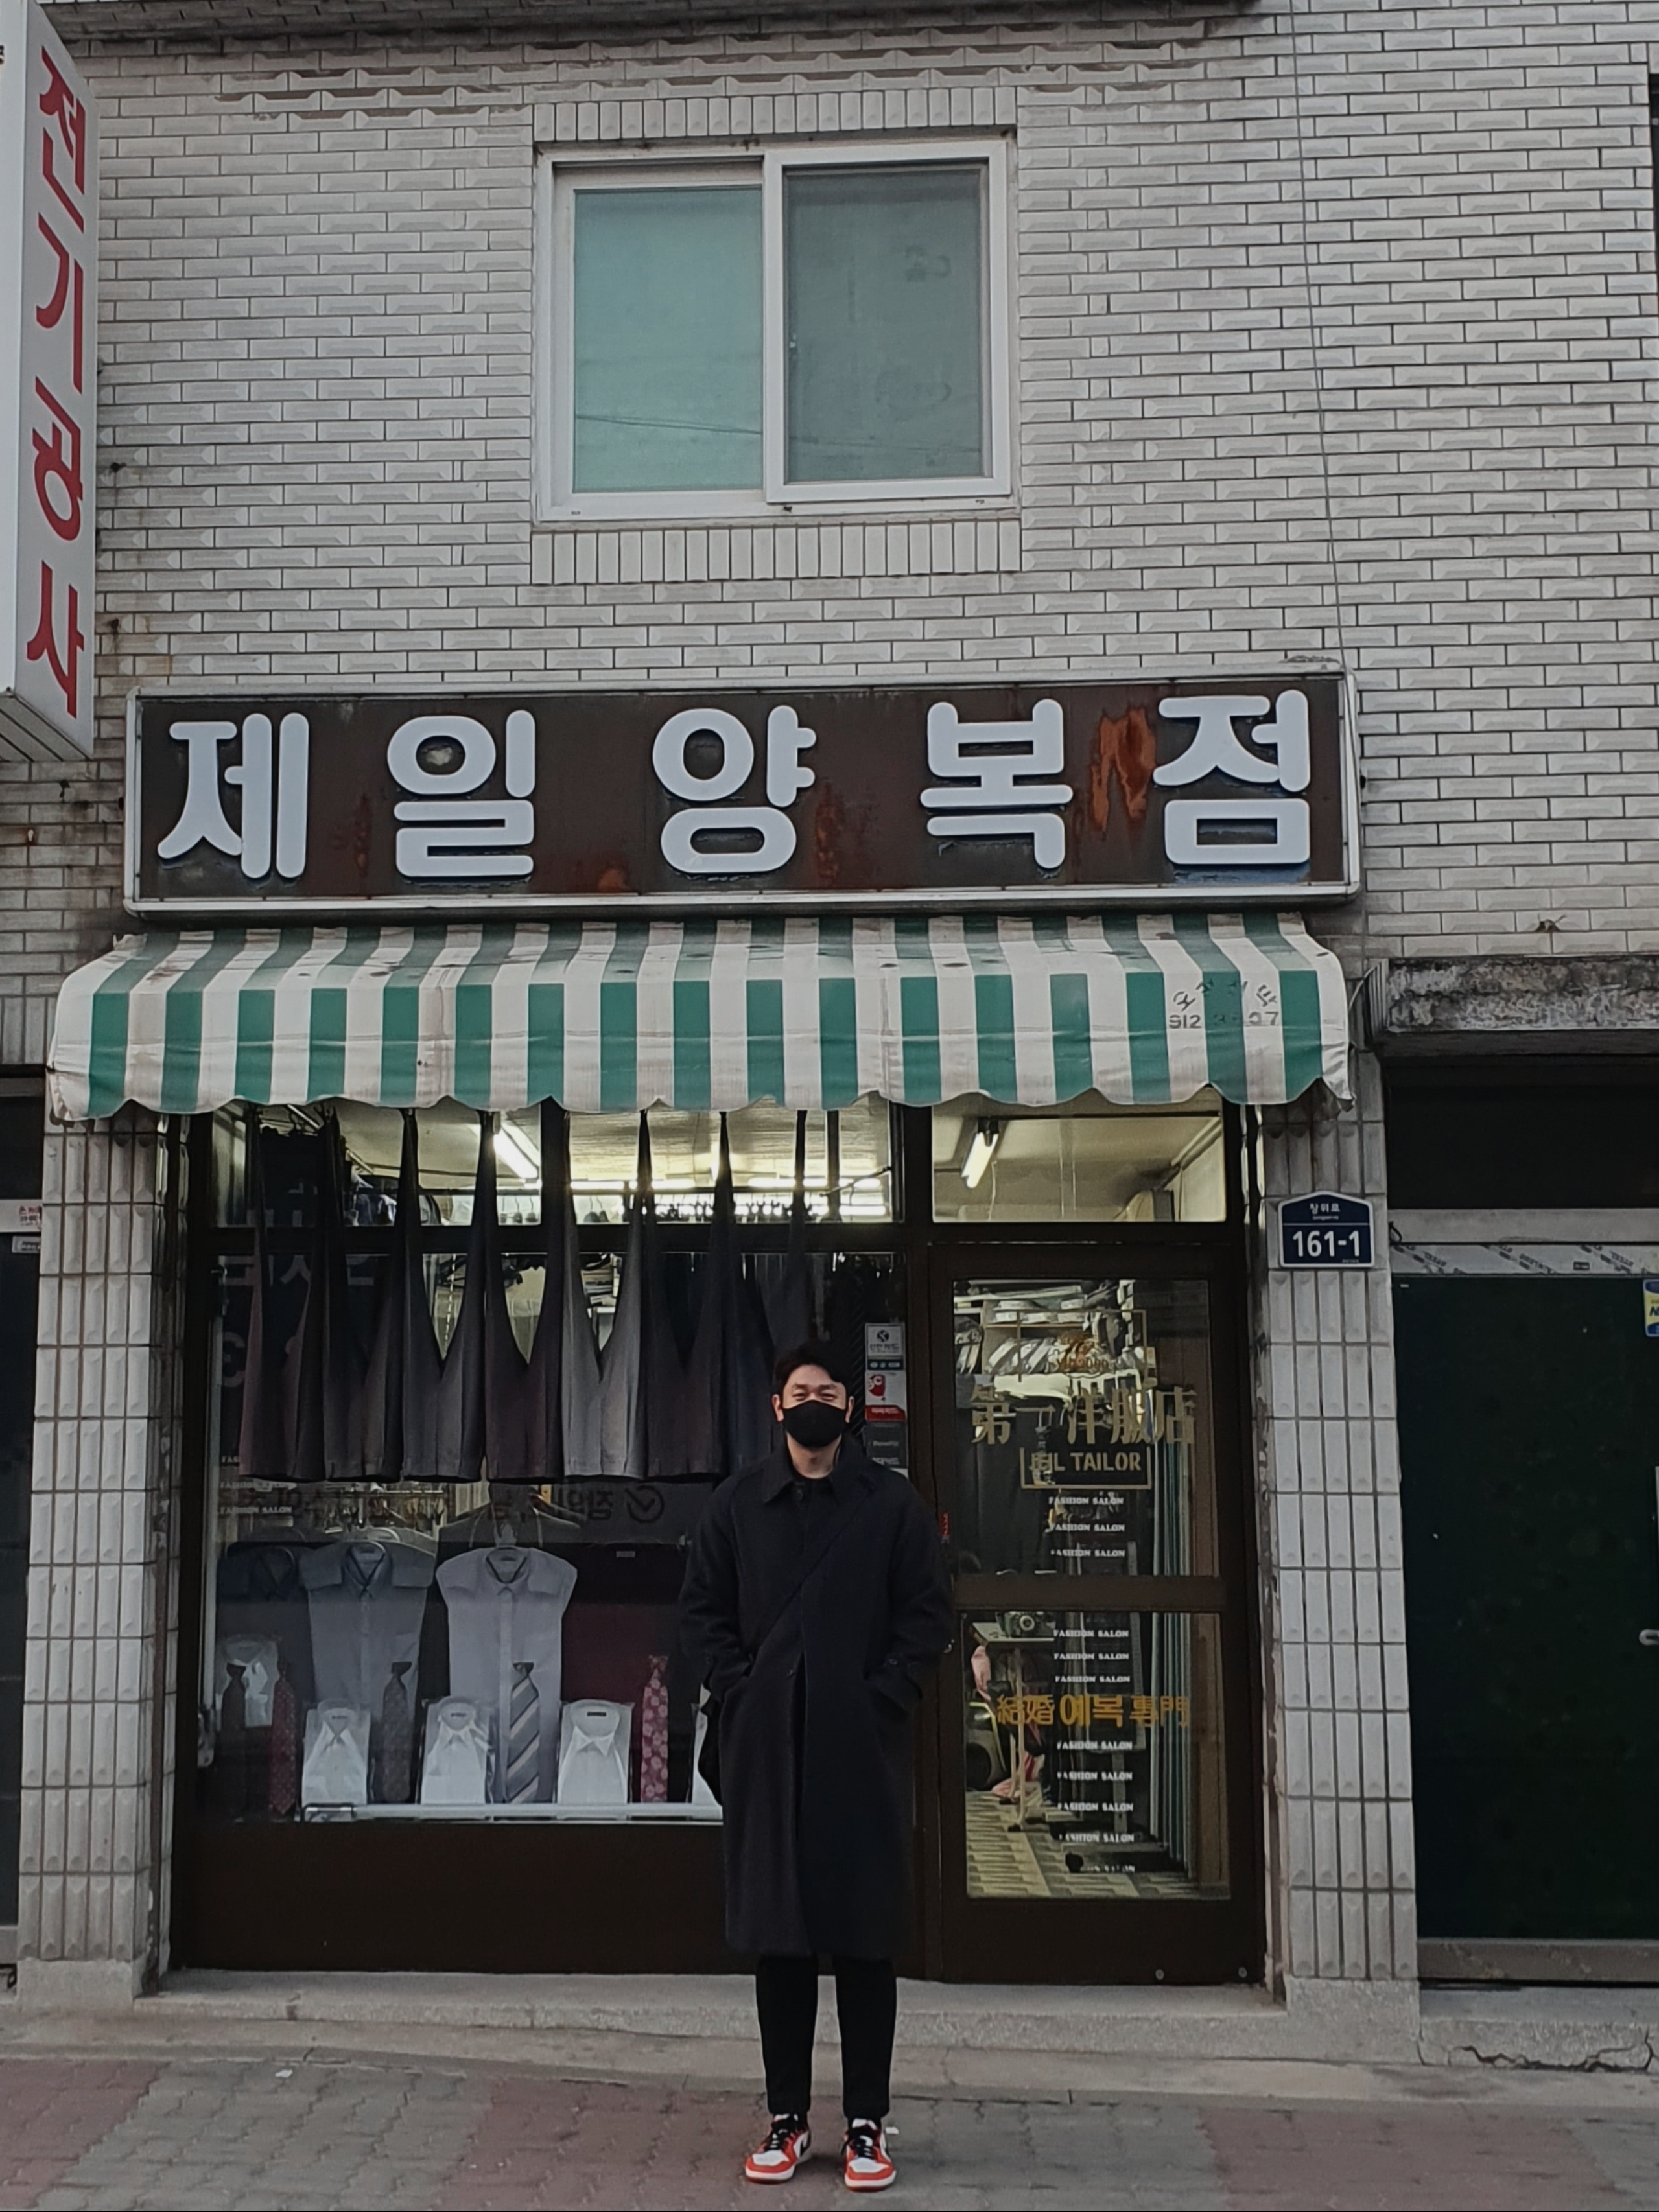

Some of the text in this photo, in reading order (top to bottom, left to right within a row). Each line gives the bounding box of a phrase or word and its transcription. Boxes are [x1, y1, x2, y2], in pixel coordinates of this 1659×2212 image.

[27, 45, 86, 718] 전기공사
[1293, 1230, 1360, 1257] 161-1
[1070, 1452, 1142, 1471] TAILOR
[1059, 1694, 1124, 1728] 예복
